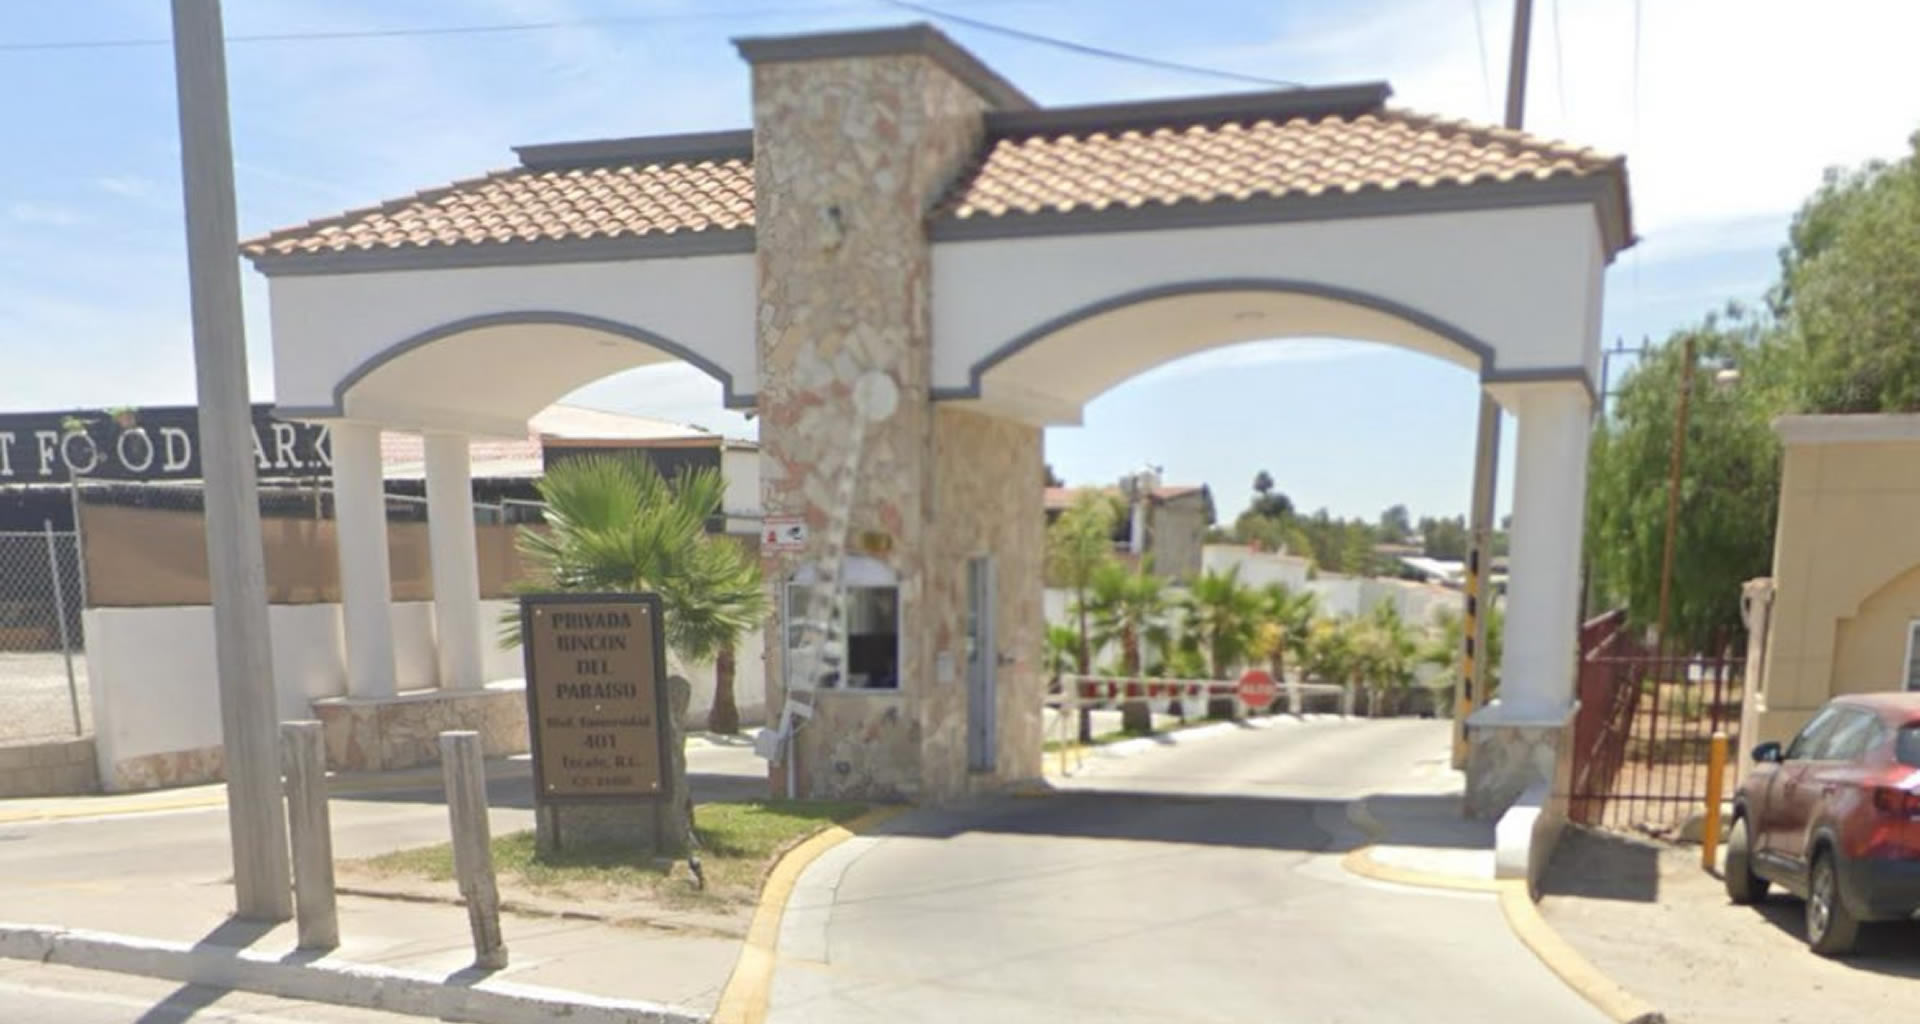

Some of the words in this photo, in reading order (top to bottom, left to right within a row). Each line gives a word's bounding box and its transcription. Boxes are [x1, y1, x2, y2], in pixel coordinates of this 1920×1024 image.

[34, 427, 192, 475] FOOD
[251, 422, 334, 468] ARK
[552, 612, 632, 629] PRIVADA
[577, 660, 614, 675] DEL
[583, 734, 617, 749] 401
